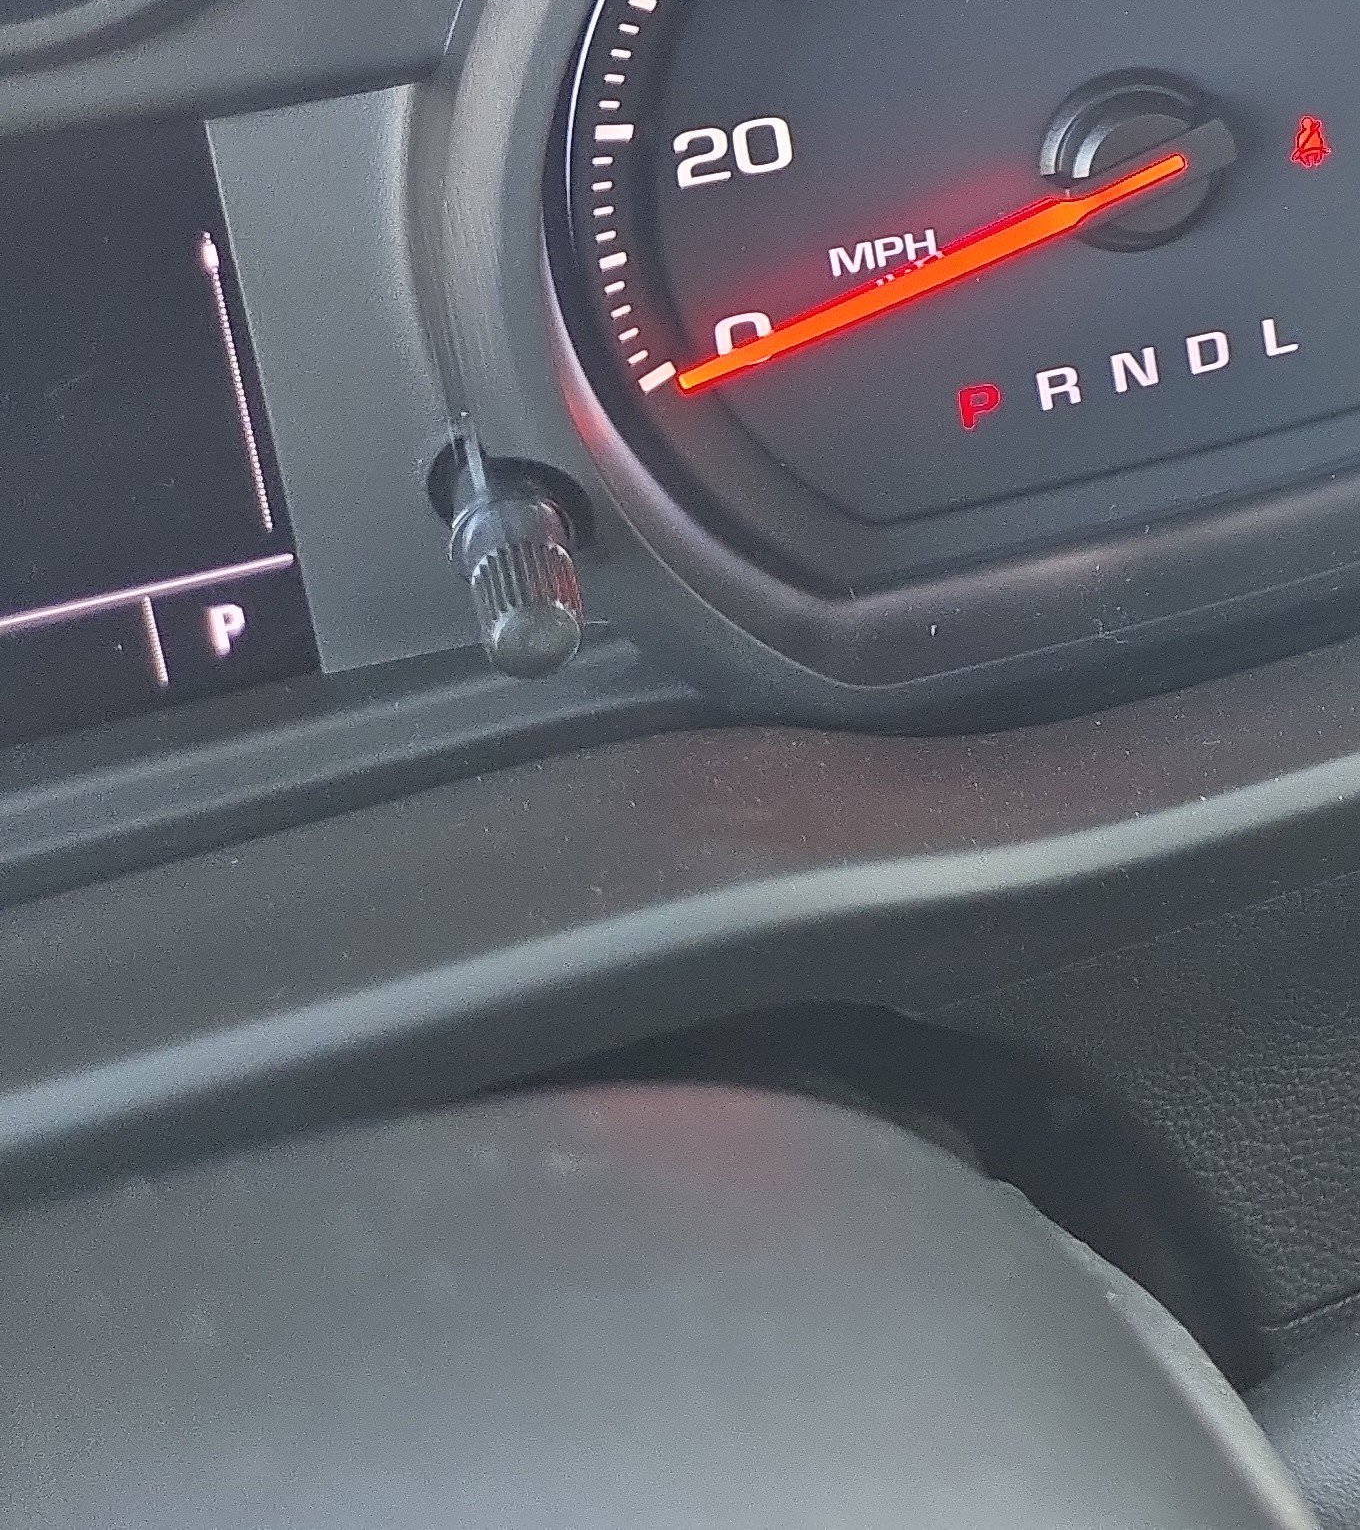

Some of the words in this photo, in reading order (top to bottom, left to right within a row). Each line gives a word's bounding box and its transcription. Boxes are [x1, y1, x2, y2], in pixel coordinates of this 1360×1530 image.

[673, 117, 793, 190] 20
[828, 228, 938, 277] MPH
[955, 382, 1003, 431] P
[1035, 366, 1082, 411] R
[1110, 346, 1159, 393] N
[1185, 331, 1230, 376] D
[1261, 318, 1299, 357] L
[207, 602, 247, 657] P
